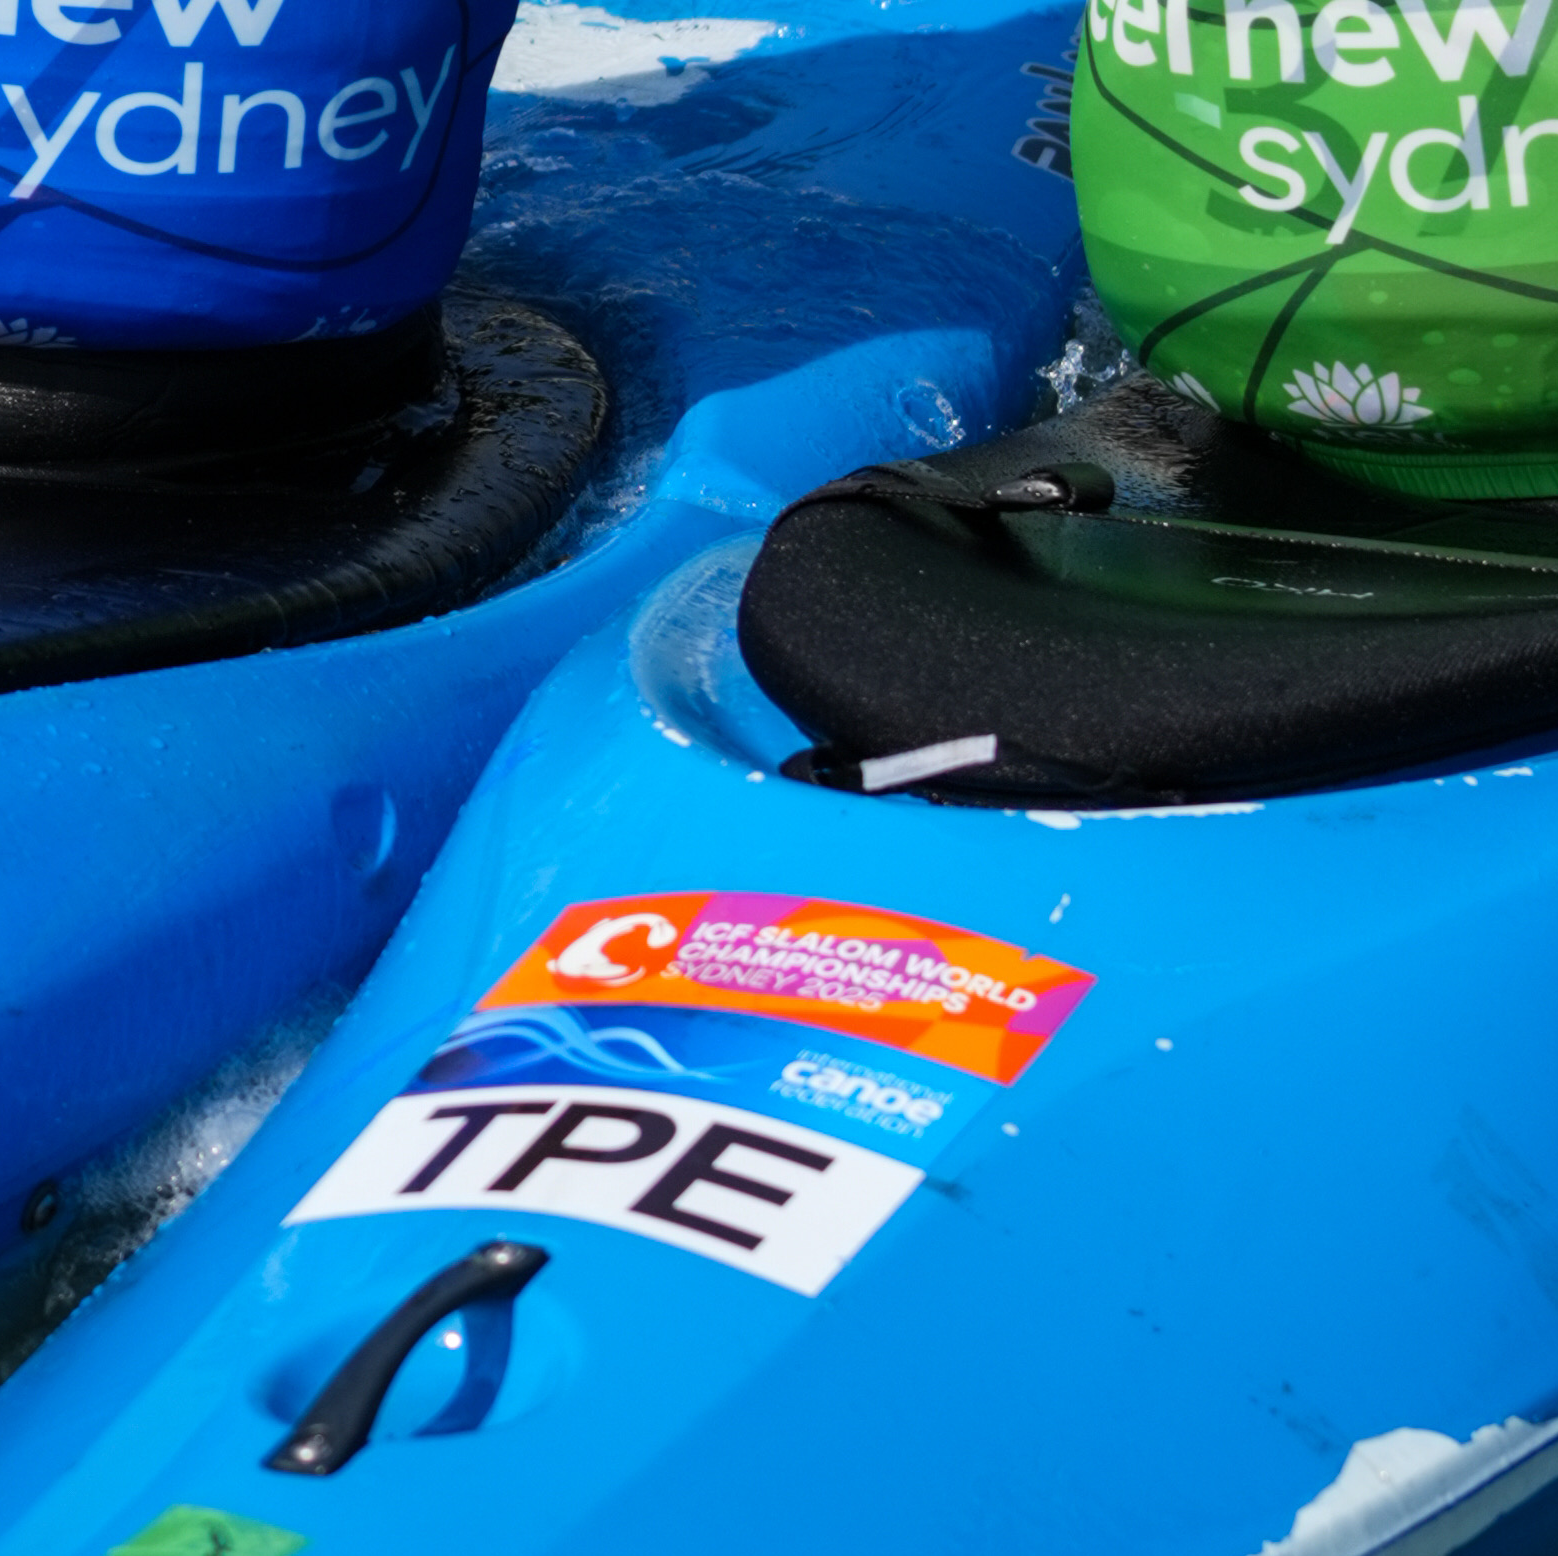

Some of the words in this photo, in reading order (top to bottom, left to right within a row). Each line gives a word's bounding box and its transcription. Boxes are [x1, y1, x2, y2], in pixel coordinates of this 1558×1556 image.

[660, 960, 799, 991] SYDNEY
[797, 977, 887, 1013] 2025
[677, 941, 970, 1015] CHAMPIONSHIPS
[692, 921, 755, 943] ICF
[753, 925, 902, 969] SLALOM
[905, 954, 1037, 1012] WORLD
[781, 1059, 944, 1127] canoe
[396, 1099, 837, 1252] TPE
